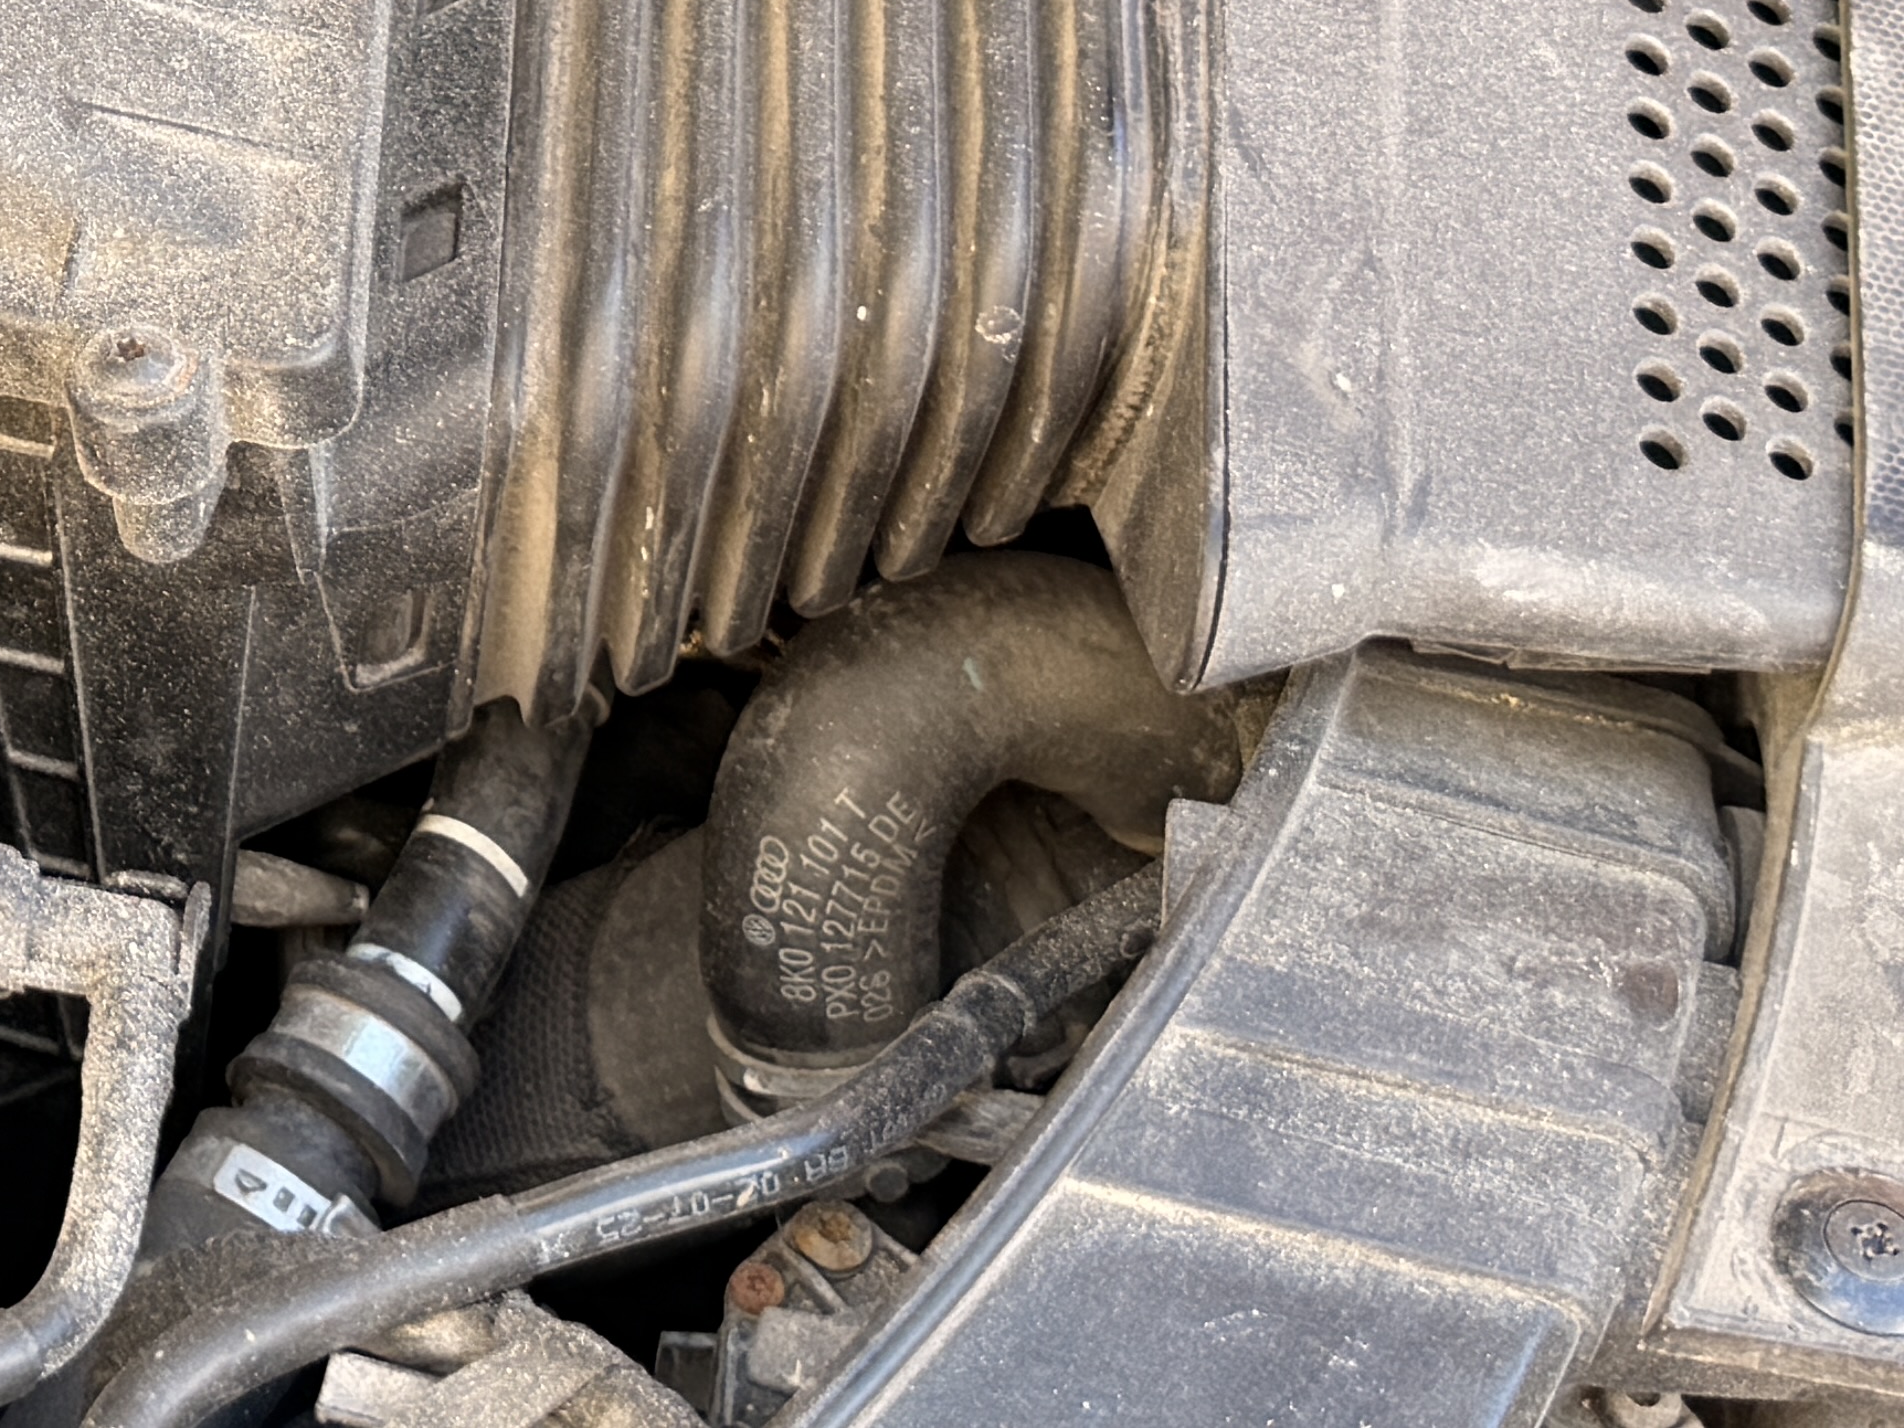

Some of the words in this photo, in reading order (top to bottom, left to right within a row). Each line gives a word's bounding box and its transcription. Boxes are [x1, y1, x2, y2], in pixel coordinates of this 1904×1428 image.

[833, 787, 867, 820] T
[867, 790, 918, 844] DE
[799, 817, 849, 877] 101
[780, 881, 823, 935] 121
[820, 841, 881, 954] 127715
[778, 947, 818, 1002] 8K0
[820, 964, 861, 1021] PX0
